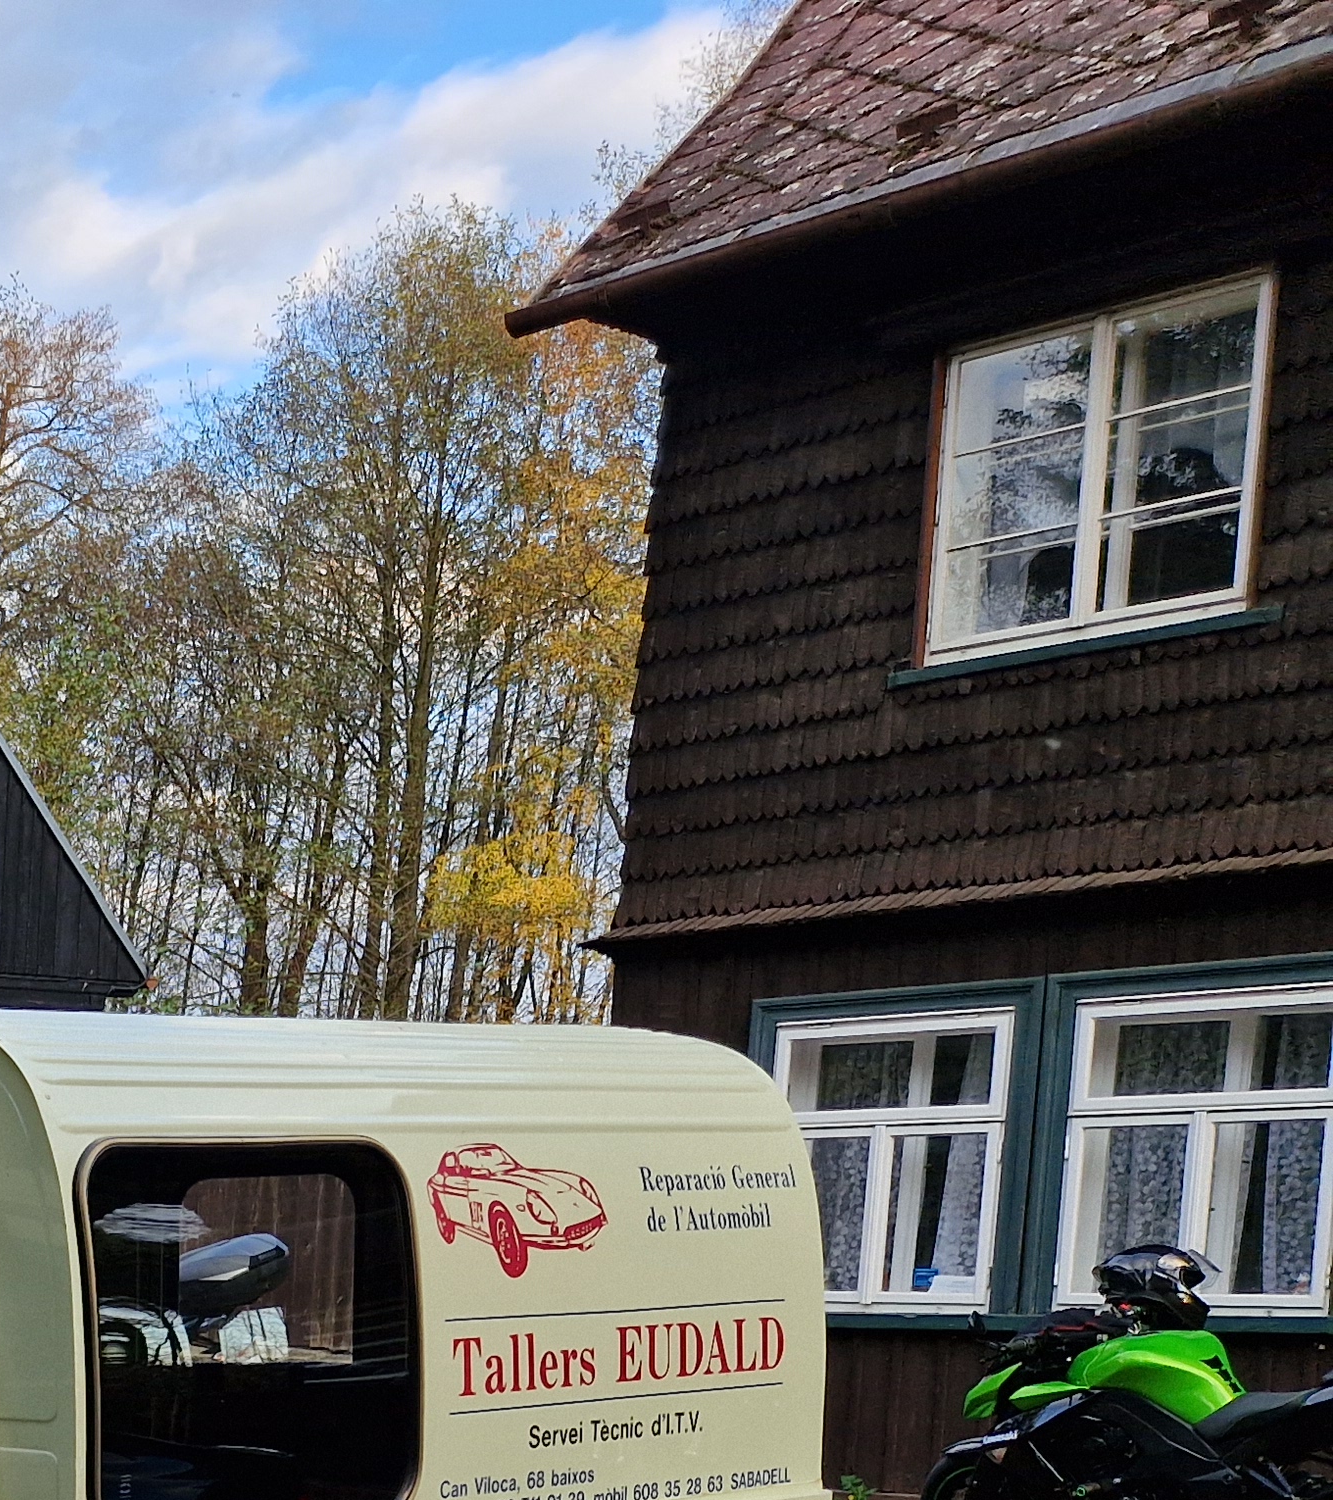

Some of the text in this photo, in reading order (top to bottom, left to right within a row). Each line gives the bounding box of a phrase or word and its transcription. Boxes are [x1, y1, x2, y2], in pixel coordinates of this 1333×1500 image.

[638, 1163, 797, 1197] Reparació General
[646, 1205, 667, 1233] de
[452, 1316, 786, 1398] Tallers EUDALD
[528, 1421, 583, 1449] Servei
[590, 1416, 644, 1442] Tècnic
[439, 1467, 595, 1499] Can Viloca, 68 baixos
[664, 1479, 681, 1498] 35
[686, 1476, 702, 1495] 28
[707, 1474, 723, 1493] 63
[730, 1467, 792, 1490] SABADELL
